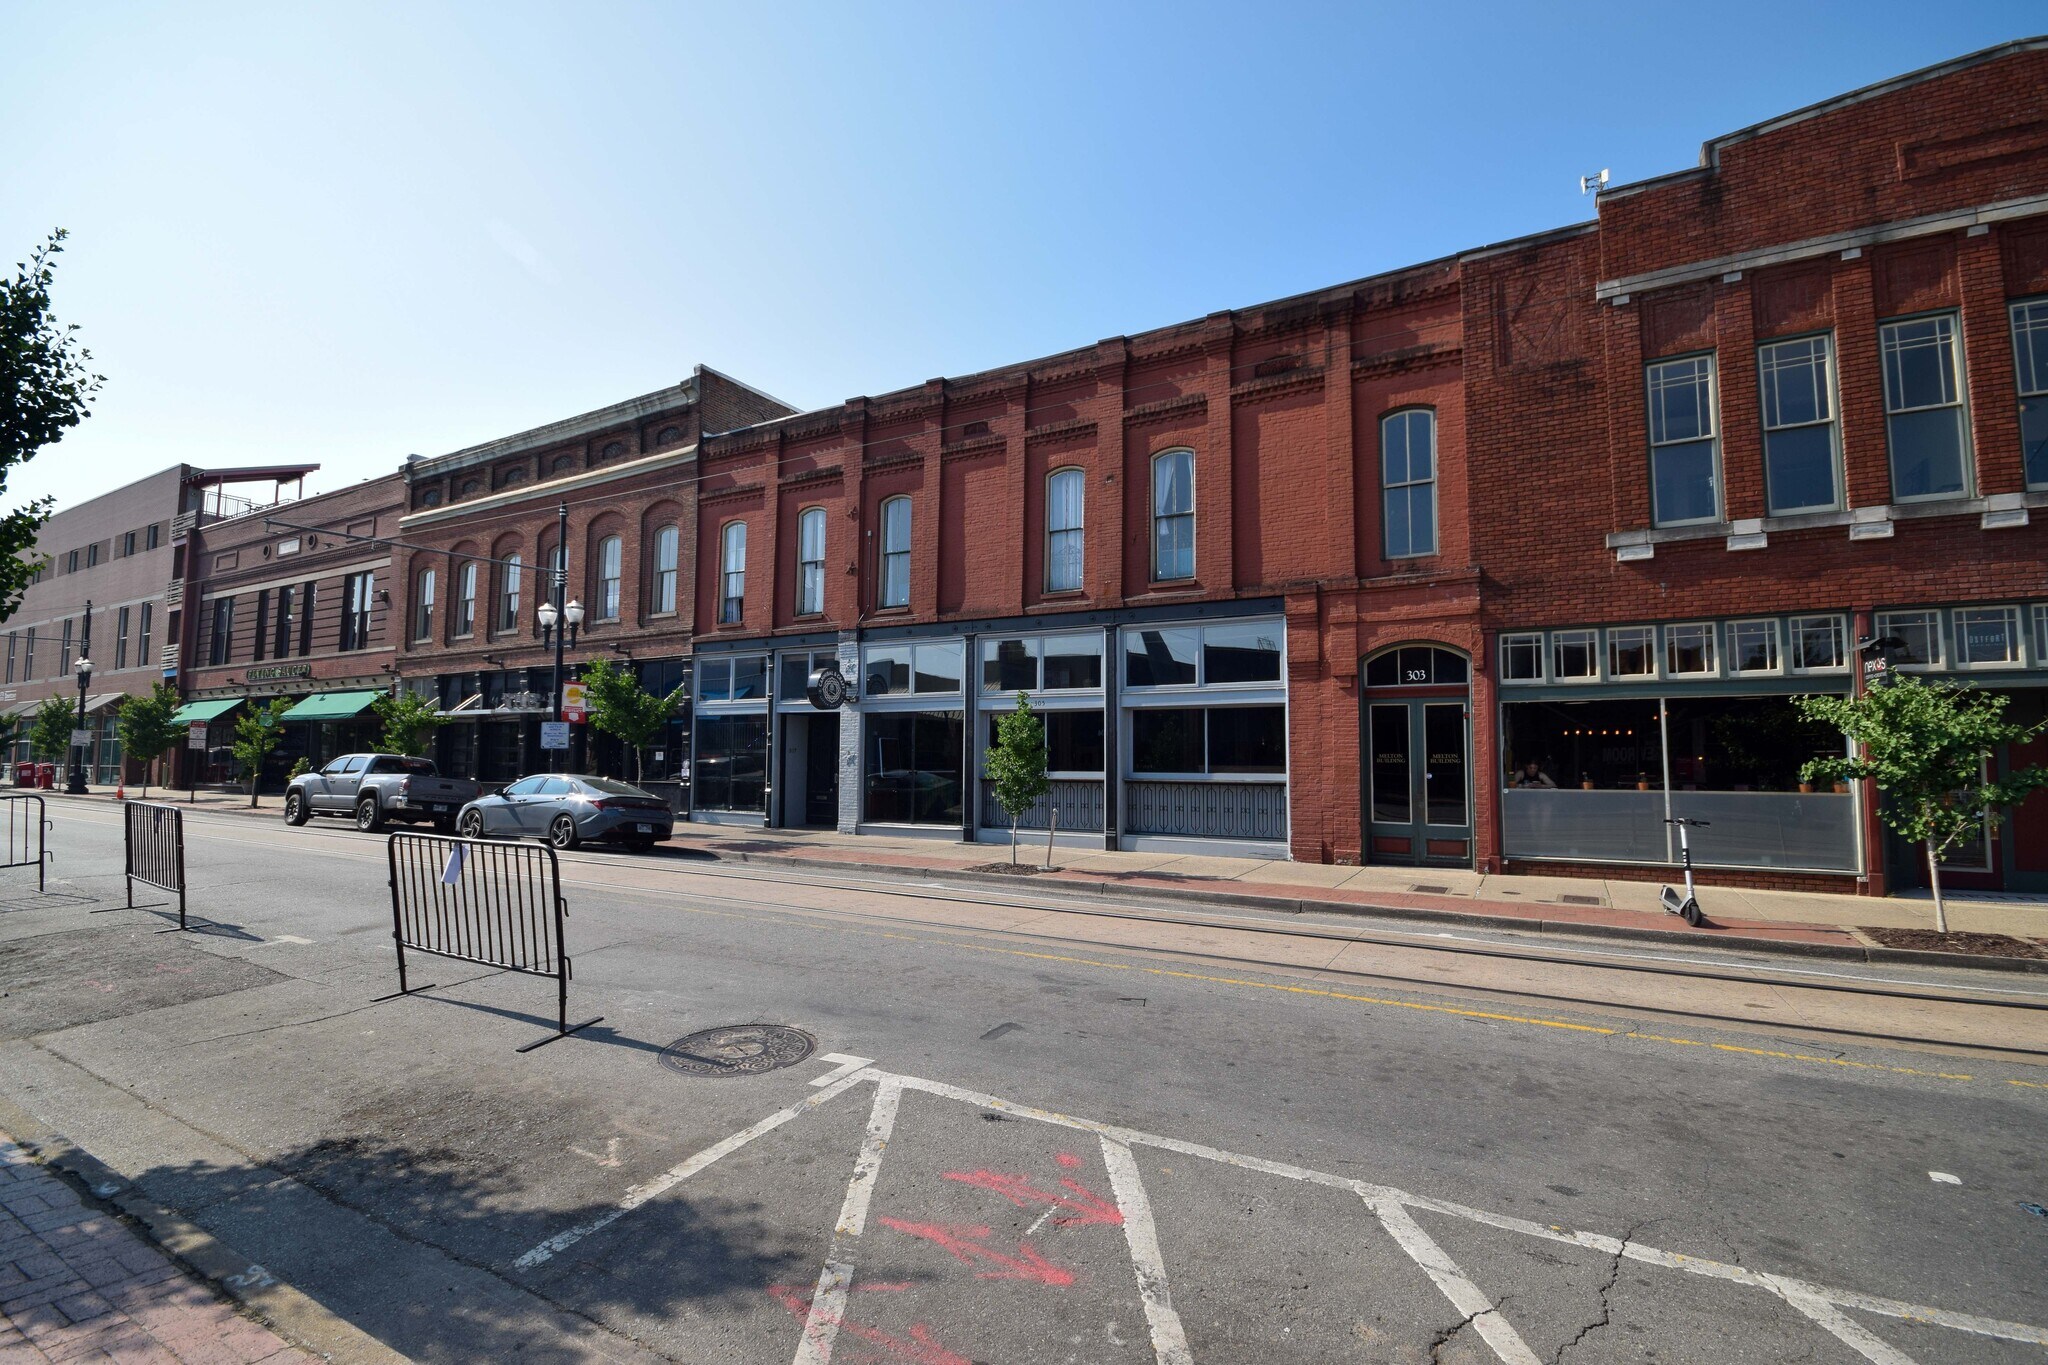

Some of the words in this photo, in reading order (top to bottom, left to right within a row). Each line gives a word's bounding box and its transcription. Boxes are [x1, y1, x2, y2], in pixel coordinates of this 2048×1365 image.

[248, 668, 275, 680] FLYING
[276, 664, 307, 678] SAUCER
[1406, 669, 1426, 681] 303
